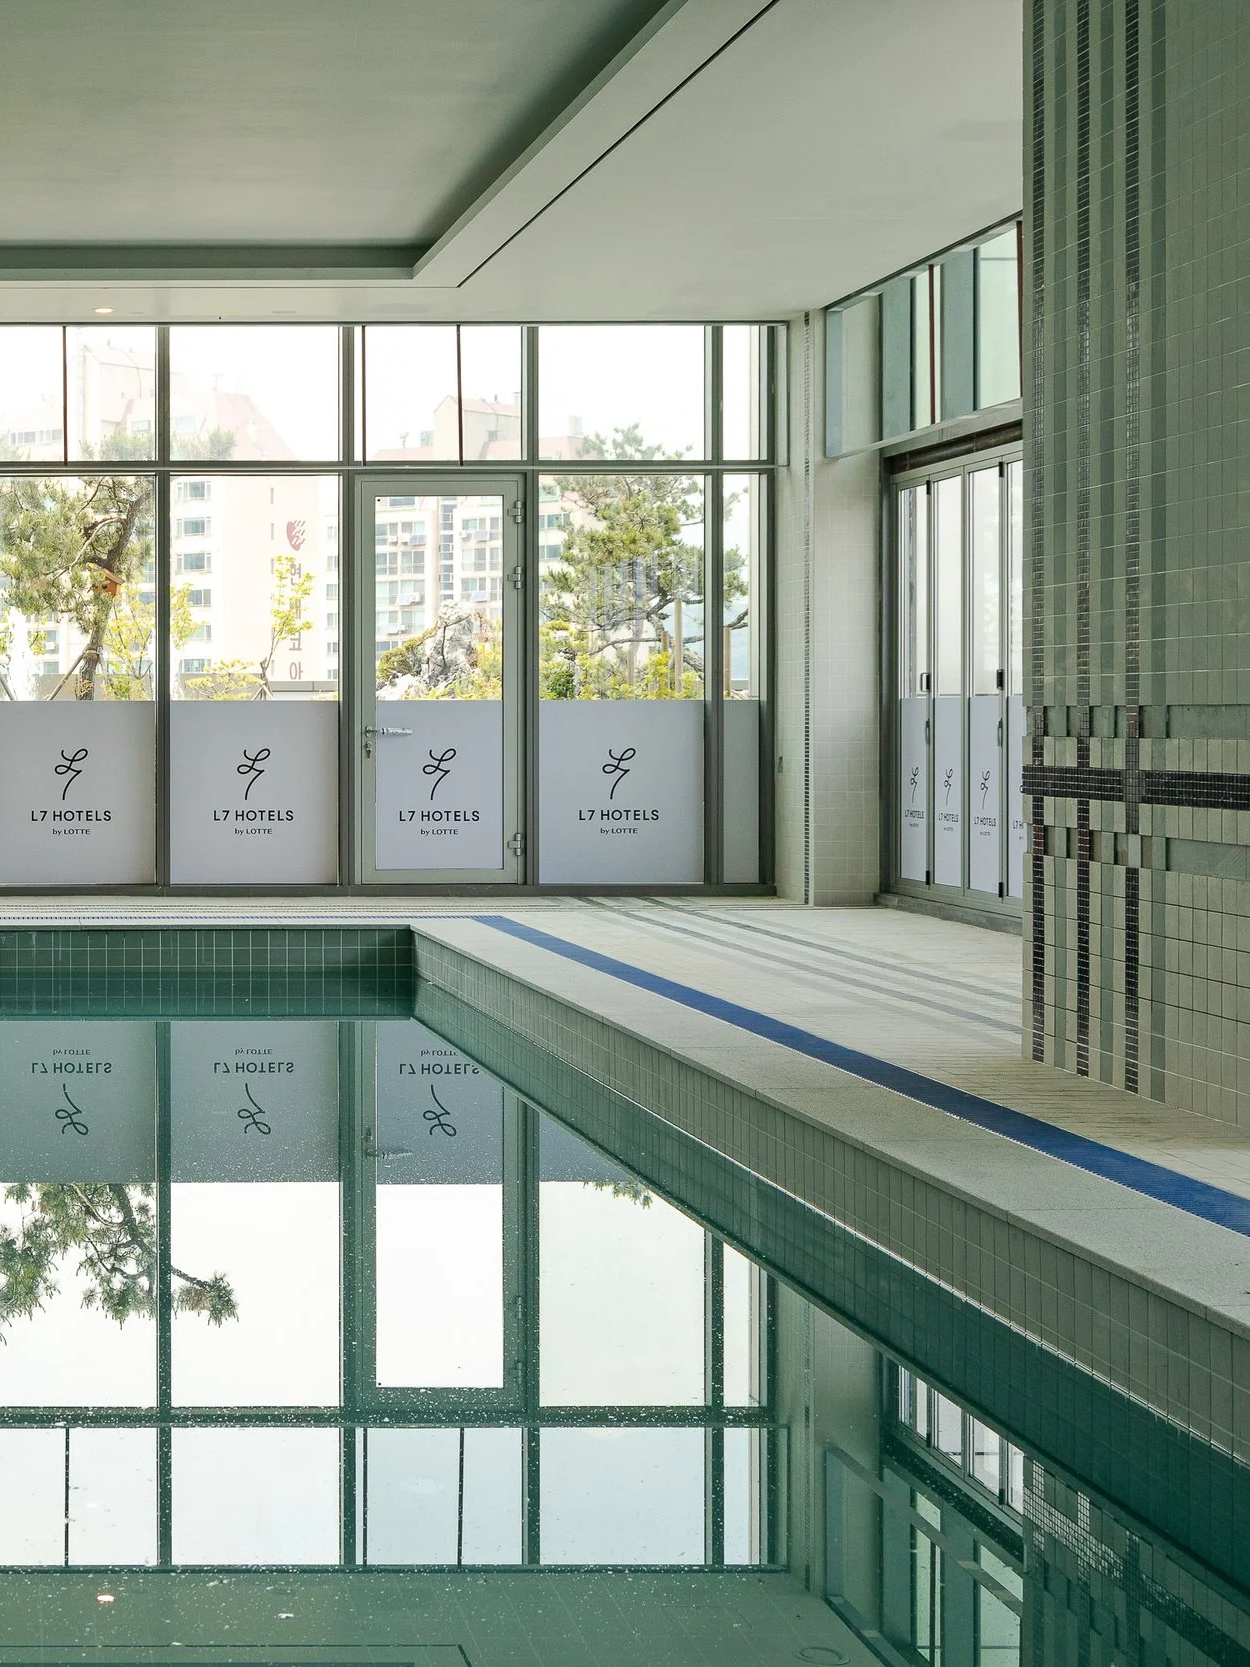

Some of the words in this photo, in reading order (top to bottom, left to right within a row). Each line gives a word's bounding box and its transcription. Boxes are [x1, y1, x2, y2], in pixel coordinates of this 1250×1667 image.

[31, 810, 48, 822] L7
[52, 810, 112, 822] HOTELS
[213, 809, 230, 821] L7
[234, 809, 294, 821] HOTELS
[399, 810, 416, 822] L7
[420, 810, 480, 822] HOTELS
[578, 809, 595, 821] L7
[599, 809, 659, 821] HOTELS
[52, 827, 63, 837] by
[64, 827, 91, 836] LOTTE
[234, 826, 245, 836] by
[246, 826, 273, 835] LOTTE
[420, 827, 431, 837] by
[432, 827, 459, 836] LOTTE
[599, 826, 610, 836] by
[611, 826, 638, 835] LOTTE
